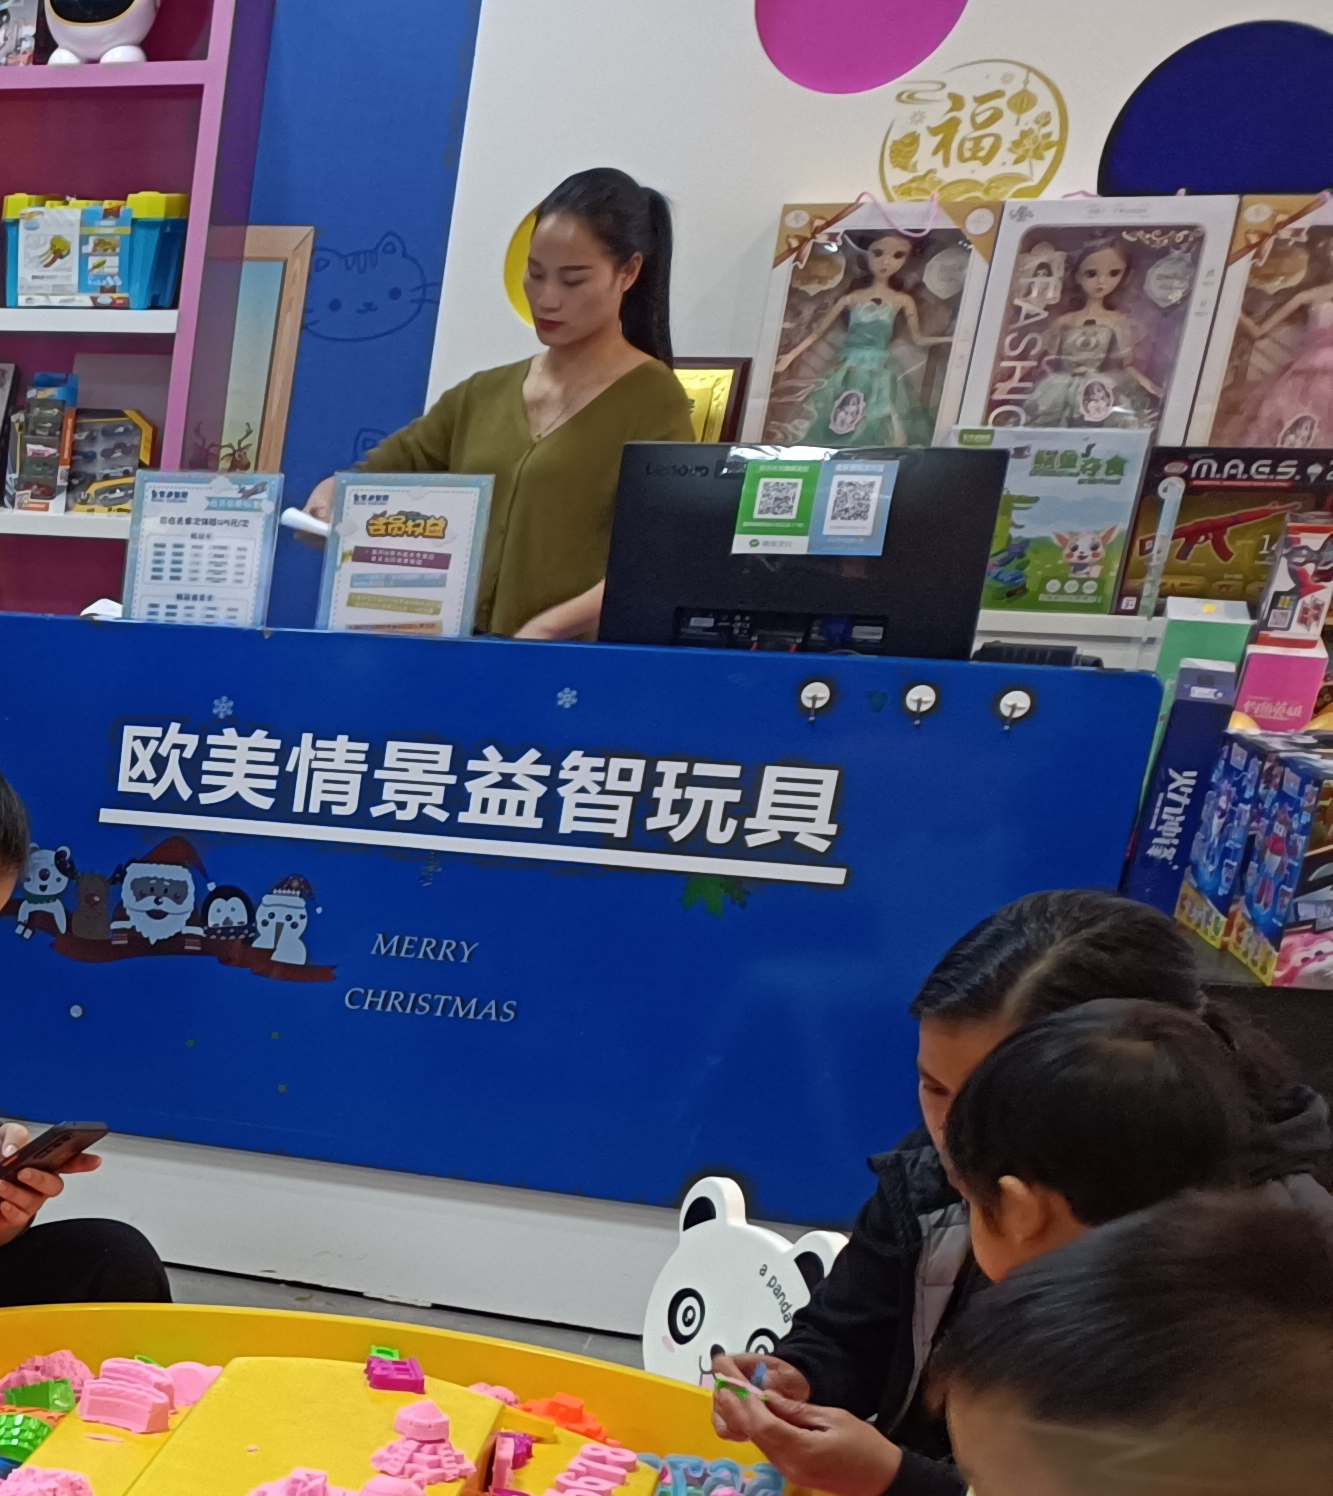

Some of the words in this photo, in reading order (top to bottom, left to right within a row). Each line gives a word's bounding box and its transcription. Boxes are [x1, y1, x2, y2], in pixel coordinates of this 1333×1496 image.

[927, 89, 1006, 168] 福
[117, 721, 840, 852] 欧美情景益智玩具
[371, 933, 480, 965] MERRY
[344, 986, 518, 1023] CHRISTMAS
[759, 1263, 768, 1277] a
[766, 1275, 793, 1324] panda
